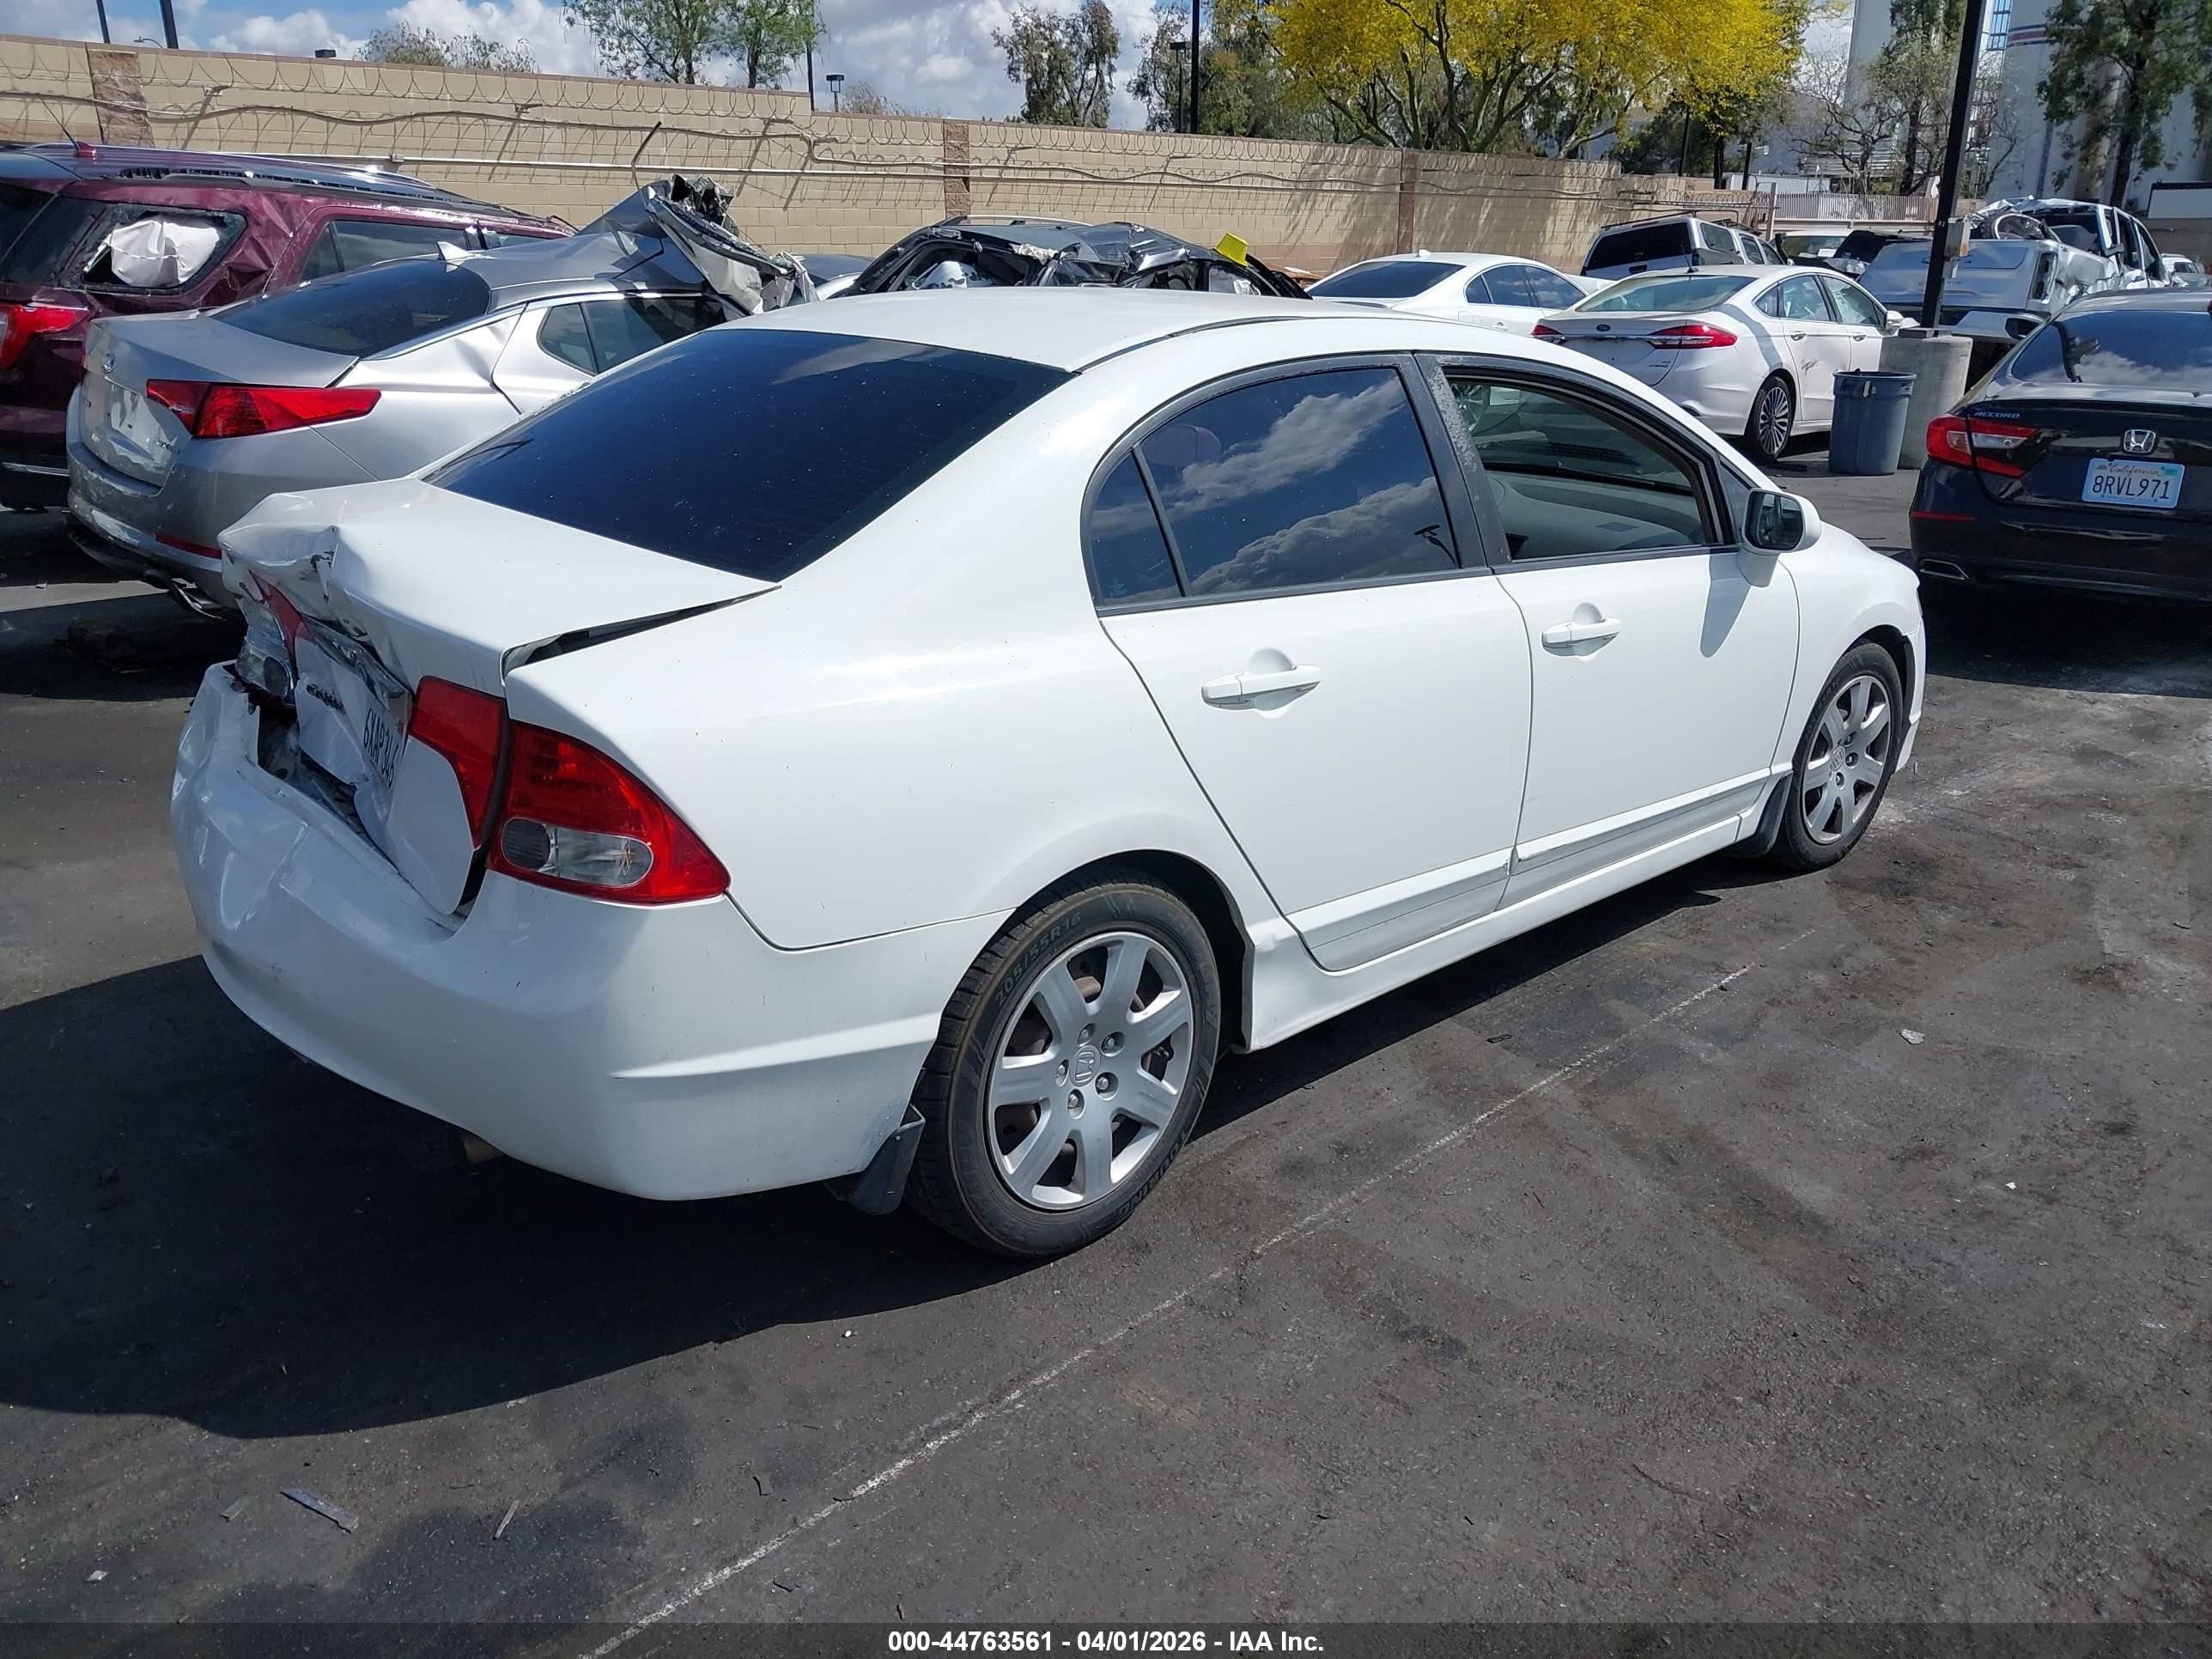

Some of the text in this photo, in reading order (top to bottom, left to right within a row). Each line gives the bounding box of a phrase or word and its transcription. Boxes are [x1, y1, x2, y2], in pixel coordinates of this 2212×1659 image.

[2109, 464, 2161, 477] California
[2093, 475, 2170, 500] 8RVL971
[995, 911, 1082, 1007] 205/55R16
